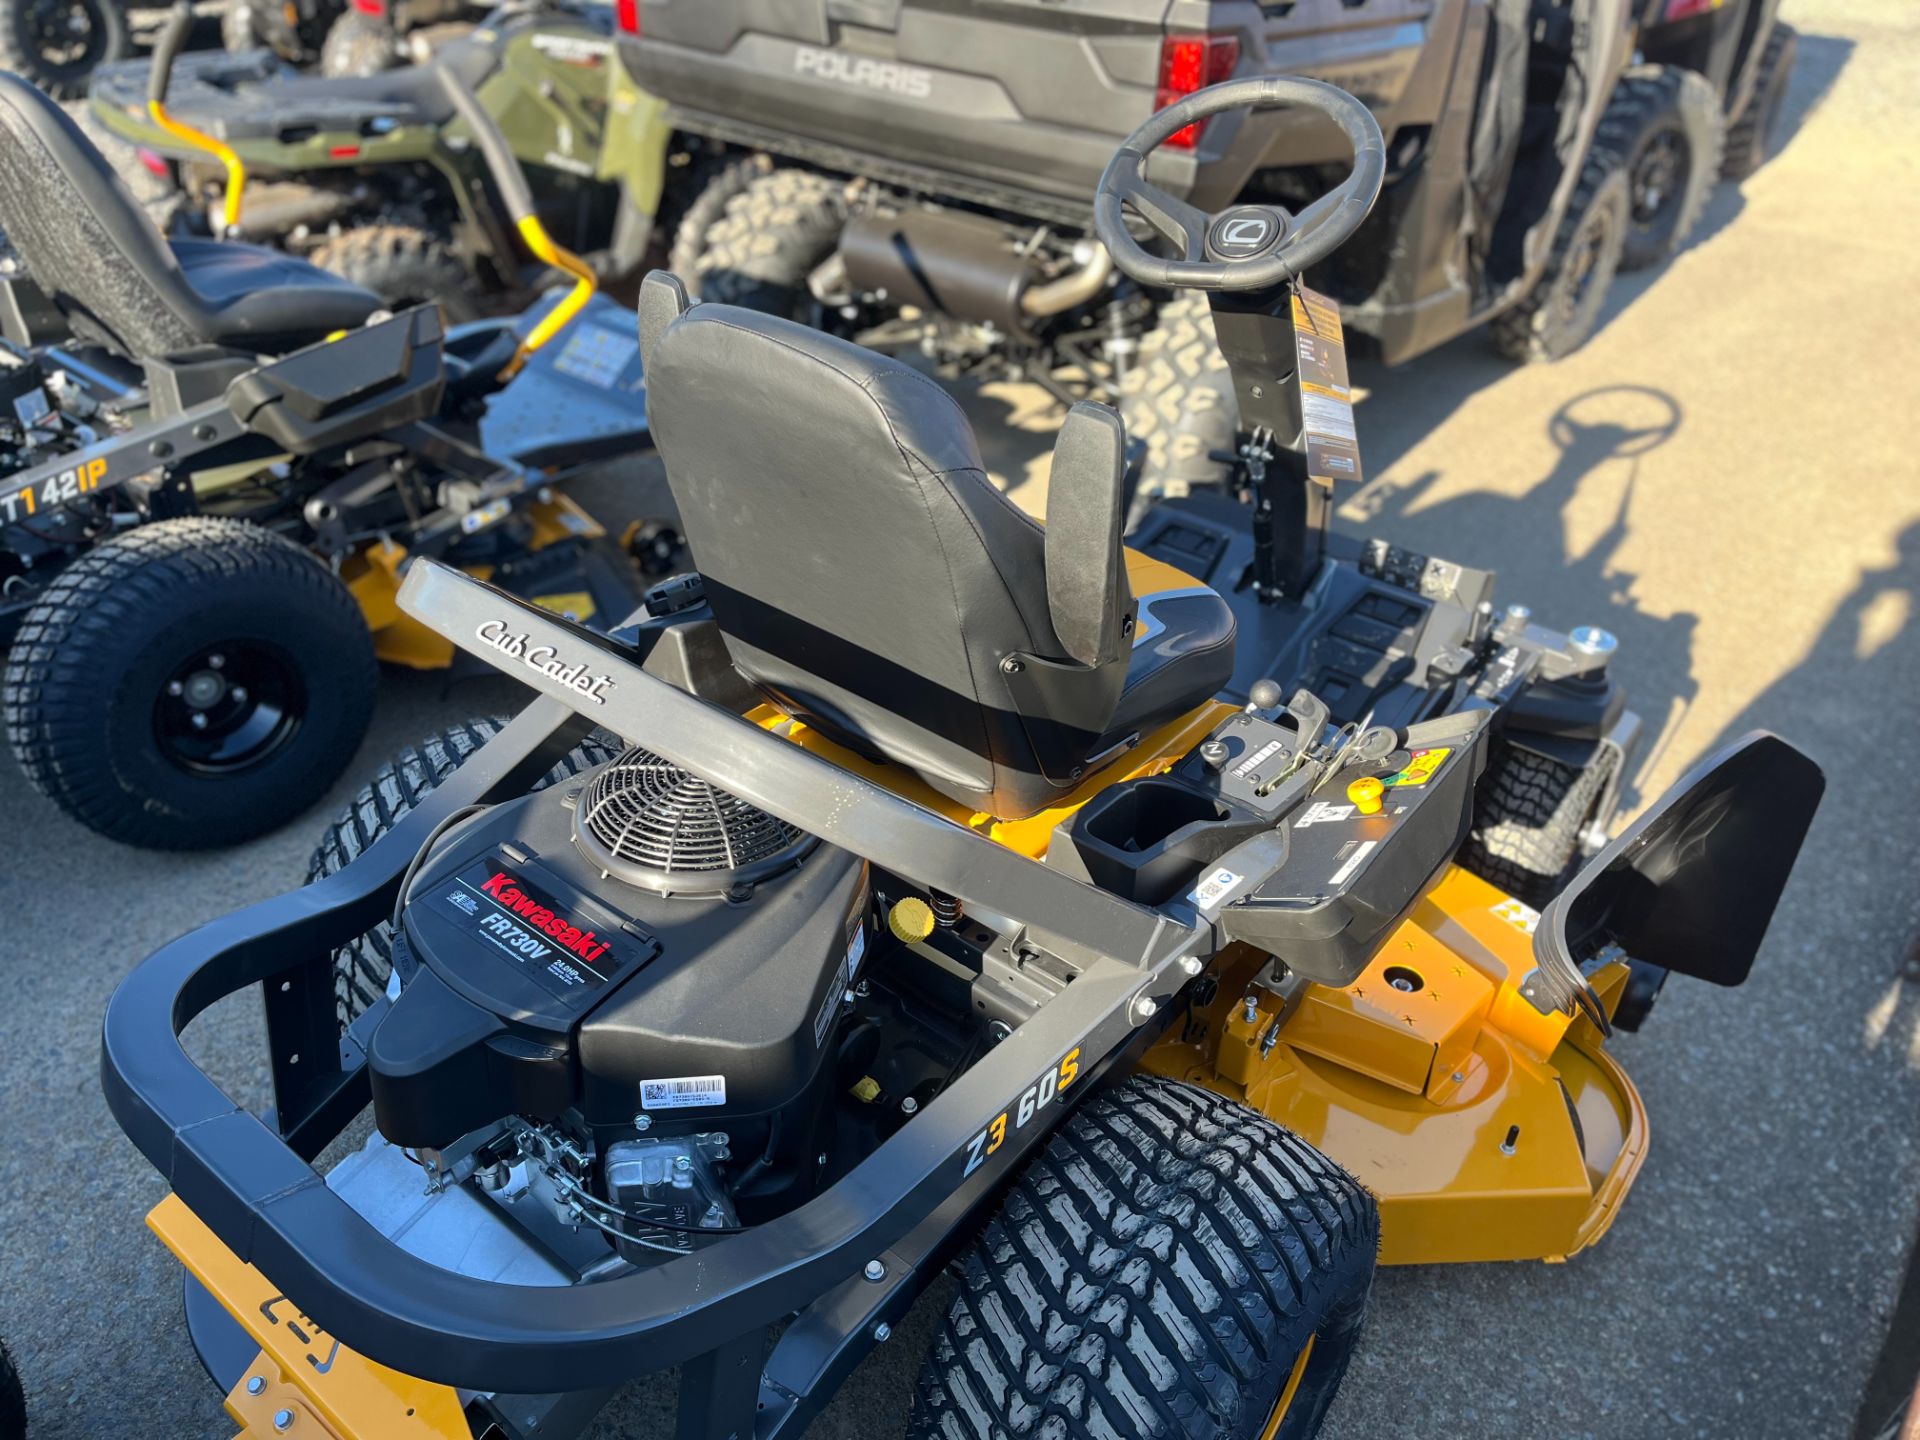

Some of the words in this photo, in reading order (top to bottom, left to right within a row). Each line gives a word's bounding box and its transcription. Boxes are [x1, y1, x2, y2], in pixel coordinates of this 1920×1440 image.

[795, 48, 932, 97] POLARIS
[0, 486, 36, 524] T1
[41, 457, 107, 505] 42IP
[475, 620, 529, 658] Cub
[525, 645, 615, 704] Cadet
[480, 872, 612, 962] Kawasaki
[480, 912, 552, 959] FR730V
[963, 1112, 1008, 1178] Z3
[1016, 1047, 1080, 1129] 60S
